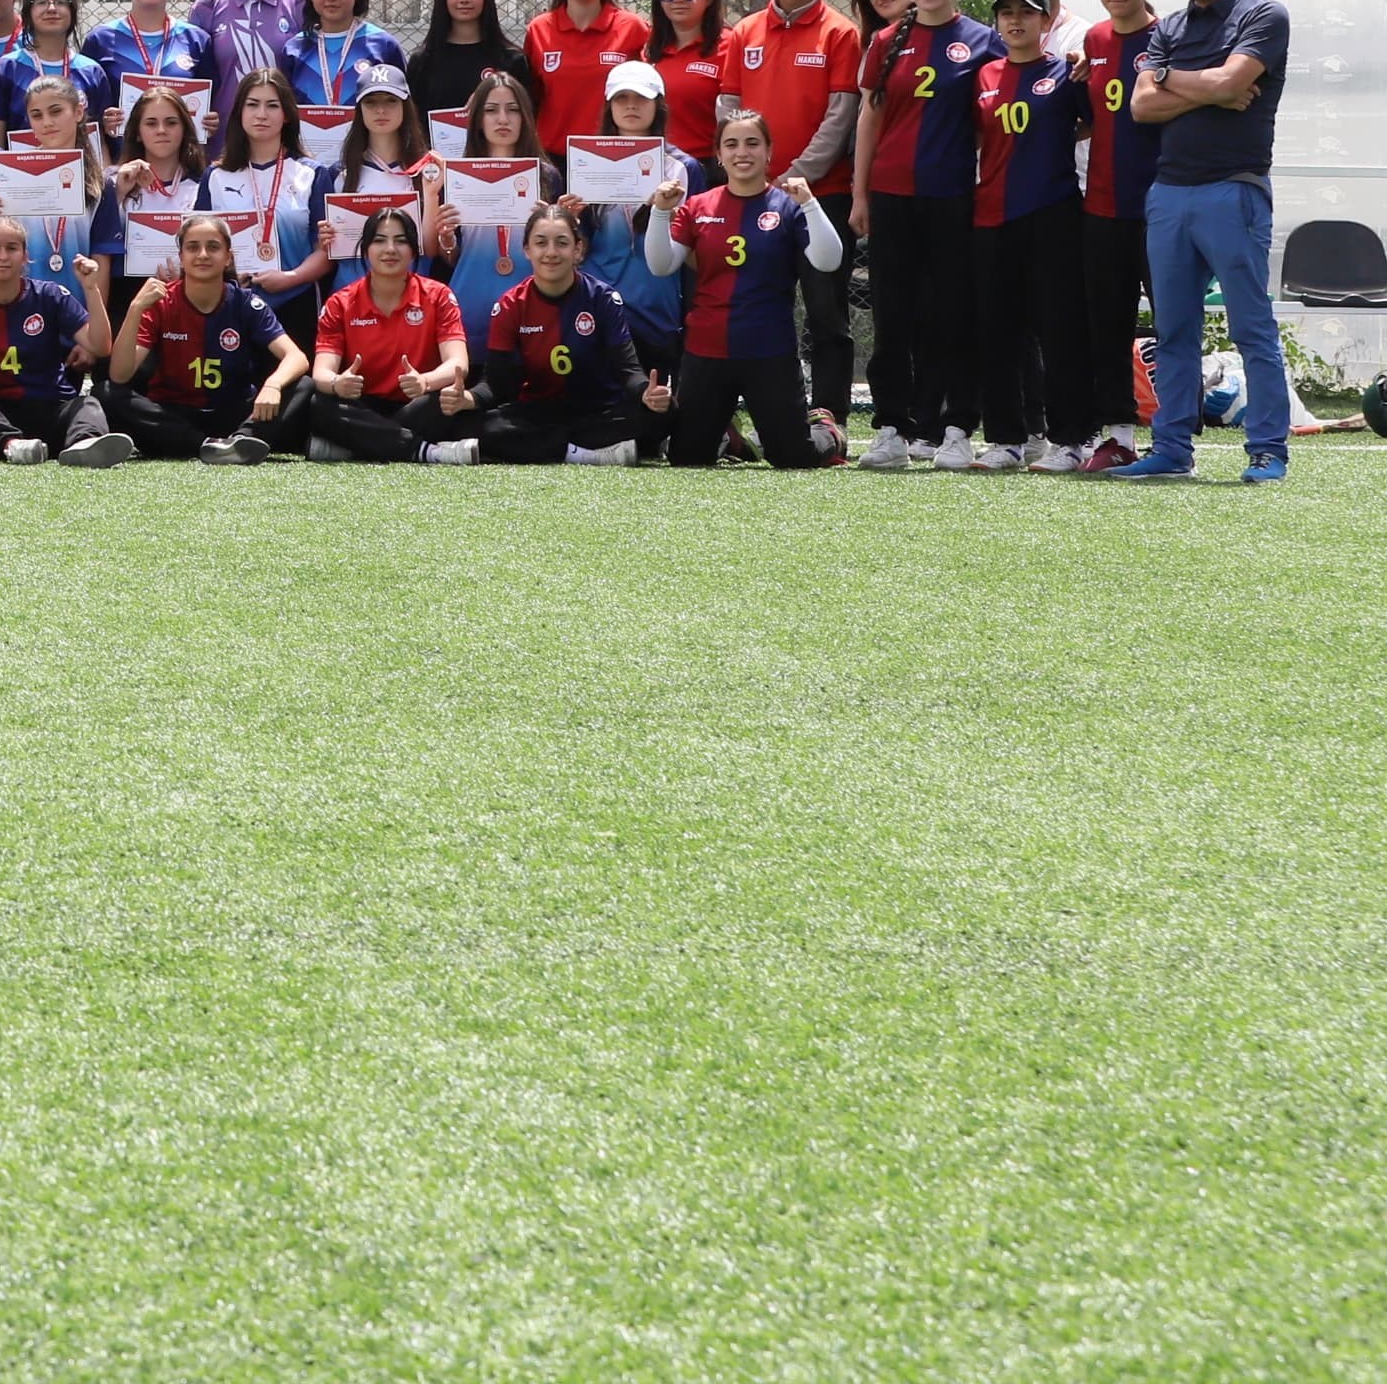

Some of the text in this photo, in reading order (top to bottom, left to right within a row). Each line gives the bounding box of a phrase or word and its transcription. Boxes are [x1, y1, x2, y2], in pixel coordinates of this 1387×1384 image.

[688, 63, 716, 75] HAKEM
[797, 56, 824, 66] HAKEM
[914, 66, 936, 97] 2
[1104, 78, 1124, 111] 9
[994, 101, 1029, 134] 10
[724, 235, 746, 267] 3
[0, 346, 22, 375] 4
[188, 356, 222, 389] 15
[549, 344, 573, 375] 6
